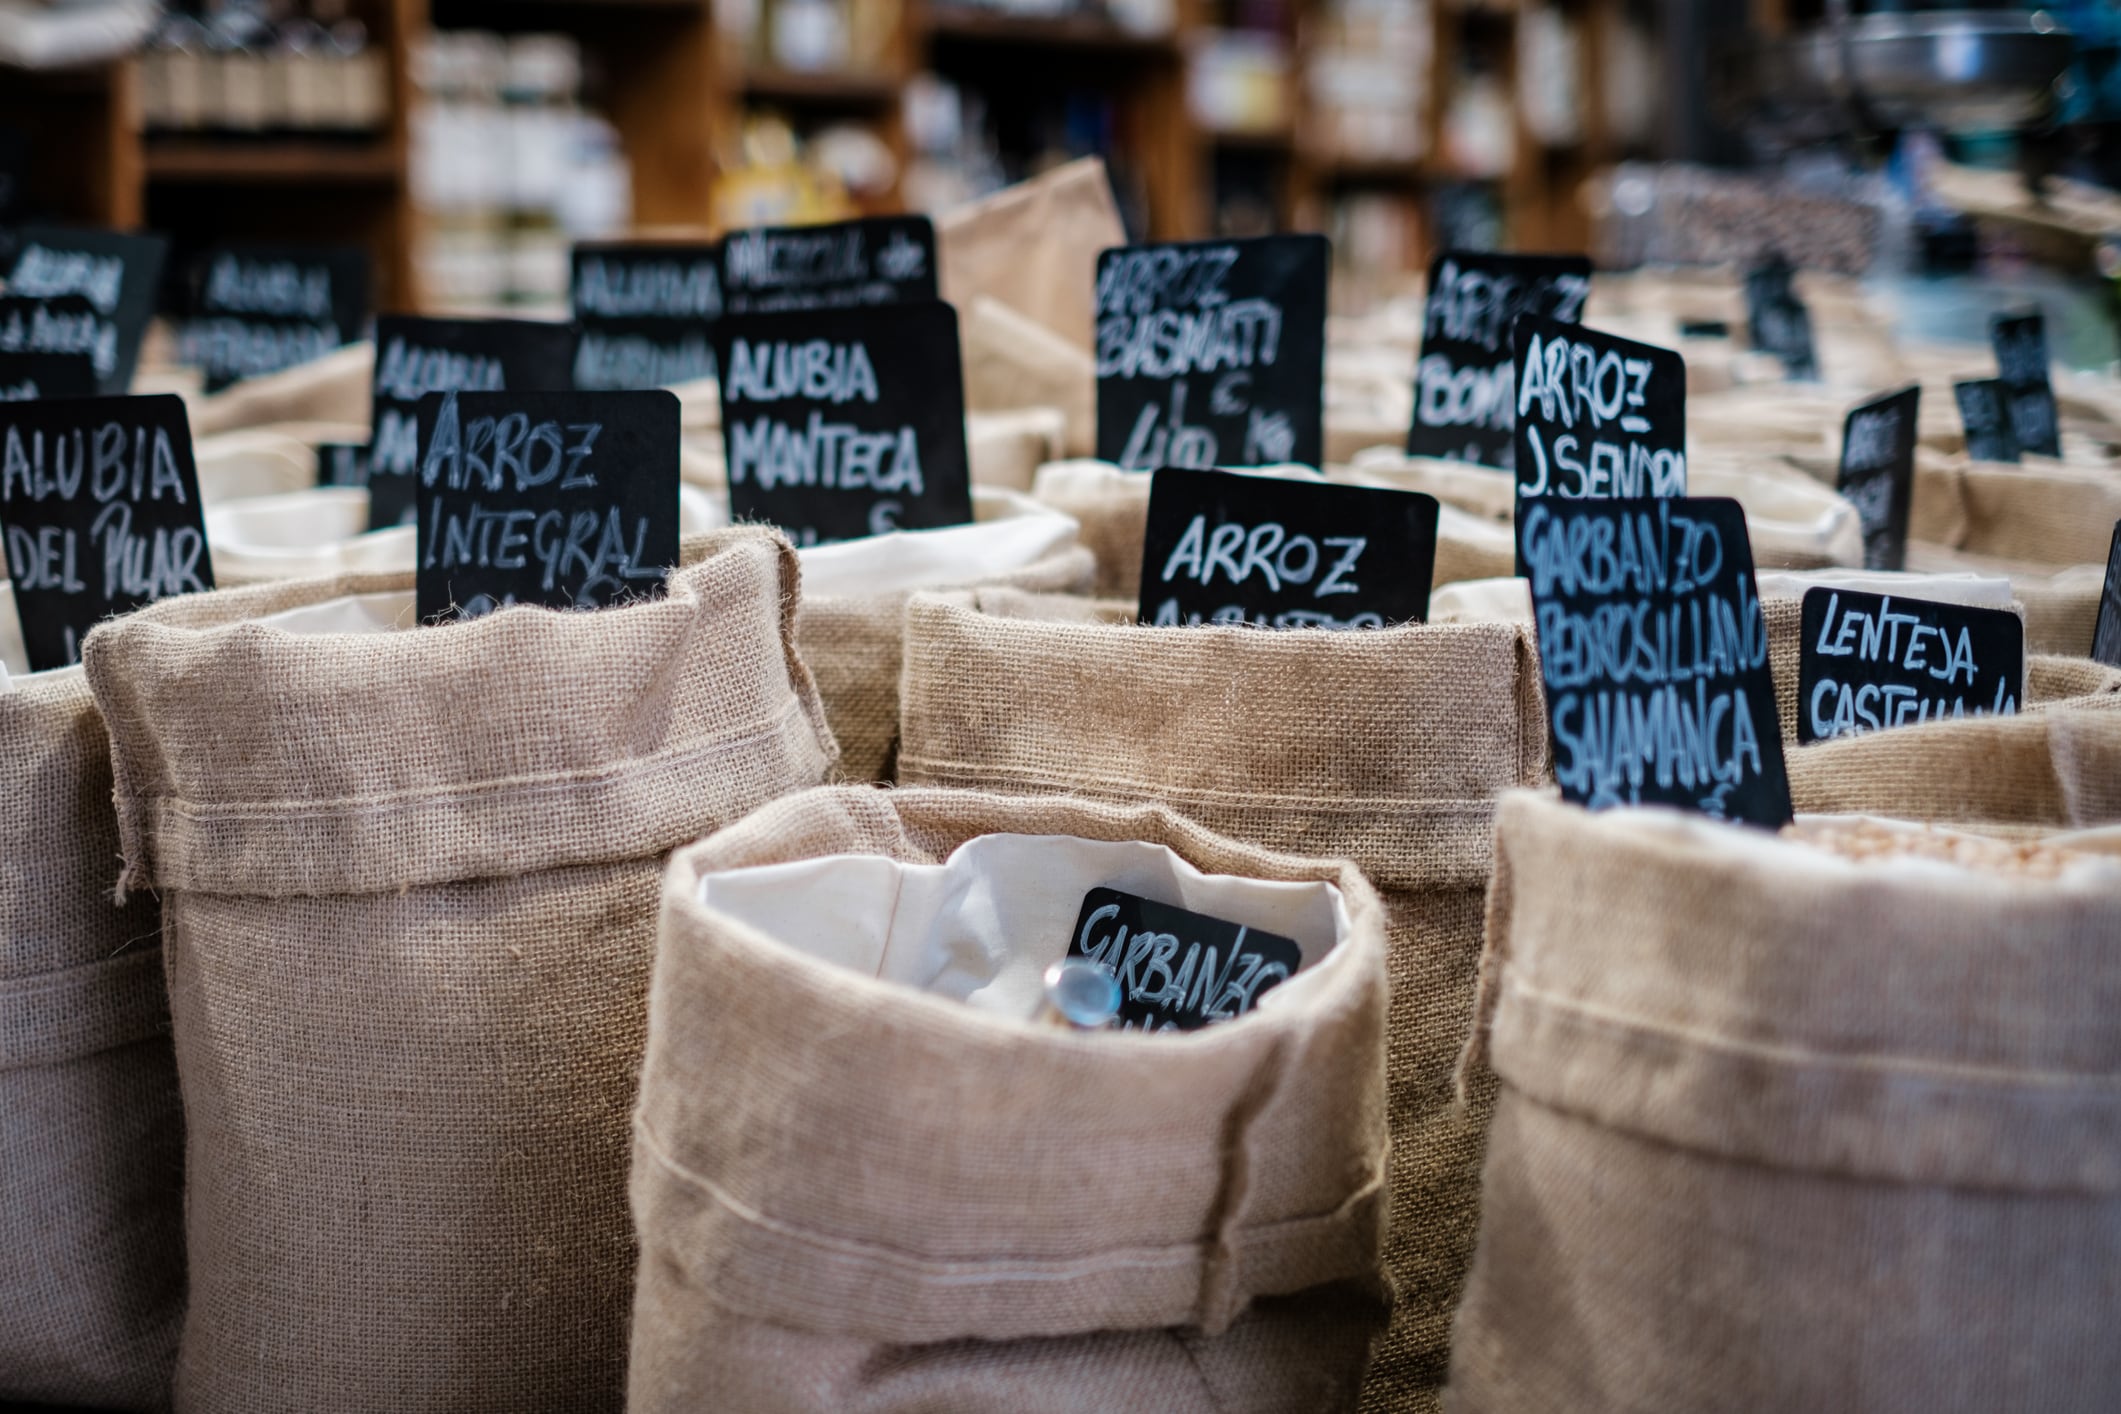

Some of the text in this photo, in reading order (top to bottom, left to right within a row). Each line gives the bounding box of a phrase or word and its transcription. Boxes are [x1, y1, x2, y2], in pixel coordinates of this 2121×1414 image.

[725, 338, 880, 405] ALUBIA
[1518, 333, 1655, 433] ARROZ
[3, 424, 187, 503] ALUBIA
[422, 390, 602, 492] ARROZ
[729, 410, 924, 497] MANTECA
[8, 502, 203, 600] DEL PILAR
[424, 497, 672, 592] INTEGRAL
[1161, 515, 1367, 598] ARROZ
[1521, 500, 1724, 597] GARBANZO
[1815, 592, 1979, 687] LENTEJA
[1552, 676, 1764, 798] SALAMANCA
[1080, 903, 1289, 1017] GARBANZO
